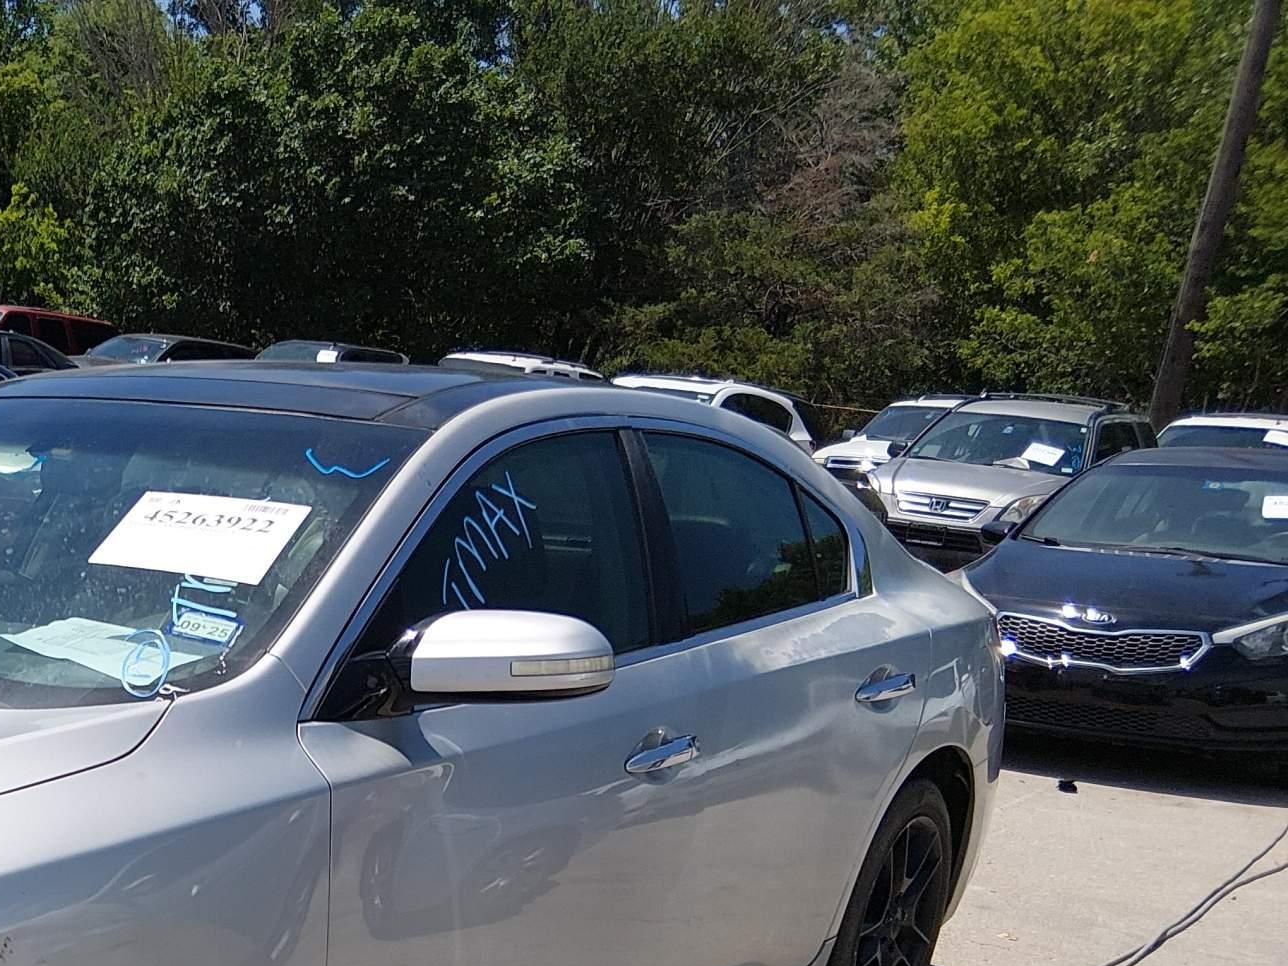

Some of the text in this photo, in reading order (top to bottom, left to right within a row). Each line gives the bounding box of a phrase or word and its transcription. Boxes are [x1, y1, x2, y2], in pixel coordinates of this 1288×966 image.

[143, 509, 276, 534] 45263922
[179, 619, 201, 632] 09
[207, 626, 230, 639] 25
